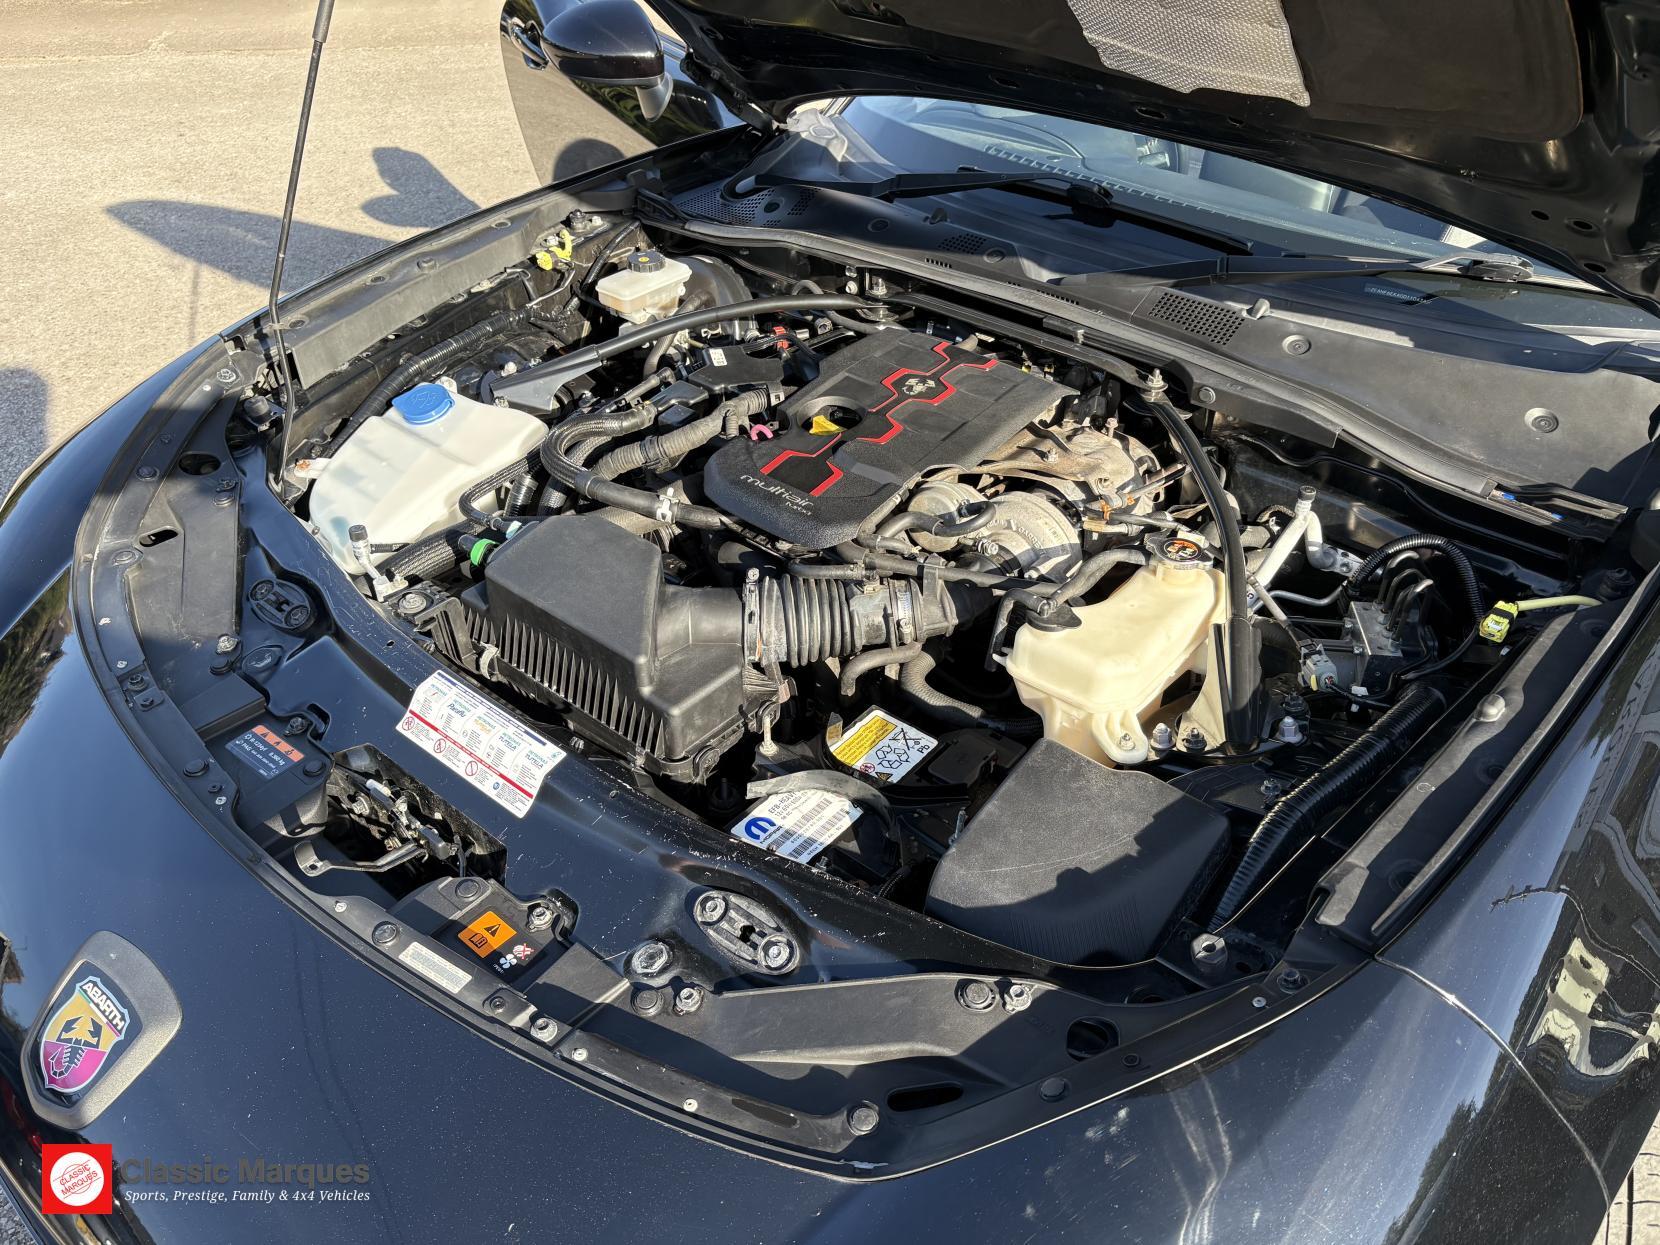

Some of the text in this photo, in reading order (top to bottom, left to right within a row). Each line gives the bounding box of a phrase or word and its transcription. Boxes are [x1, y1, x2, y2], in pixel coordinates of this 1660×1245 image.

[740, 475, 814, 506] multiair
[917, 744, 930, 754] Pb
[82, 982, 125, 1030] ABARTH
